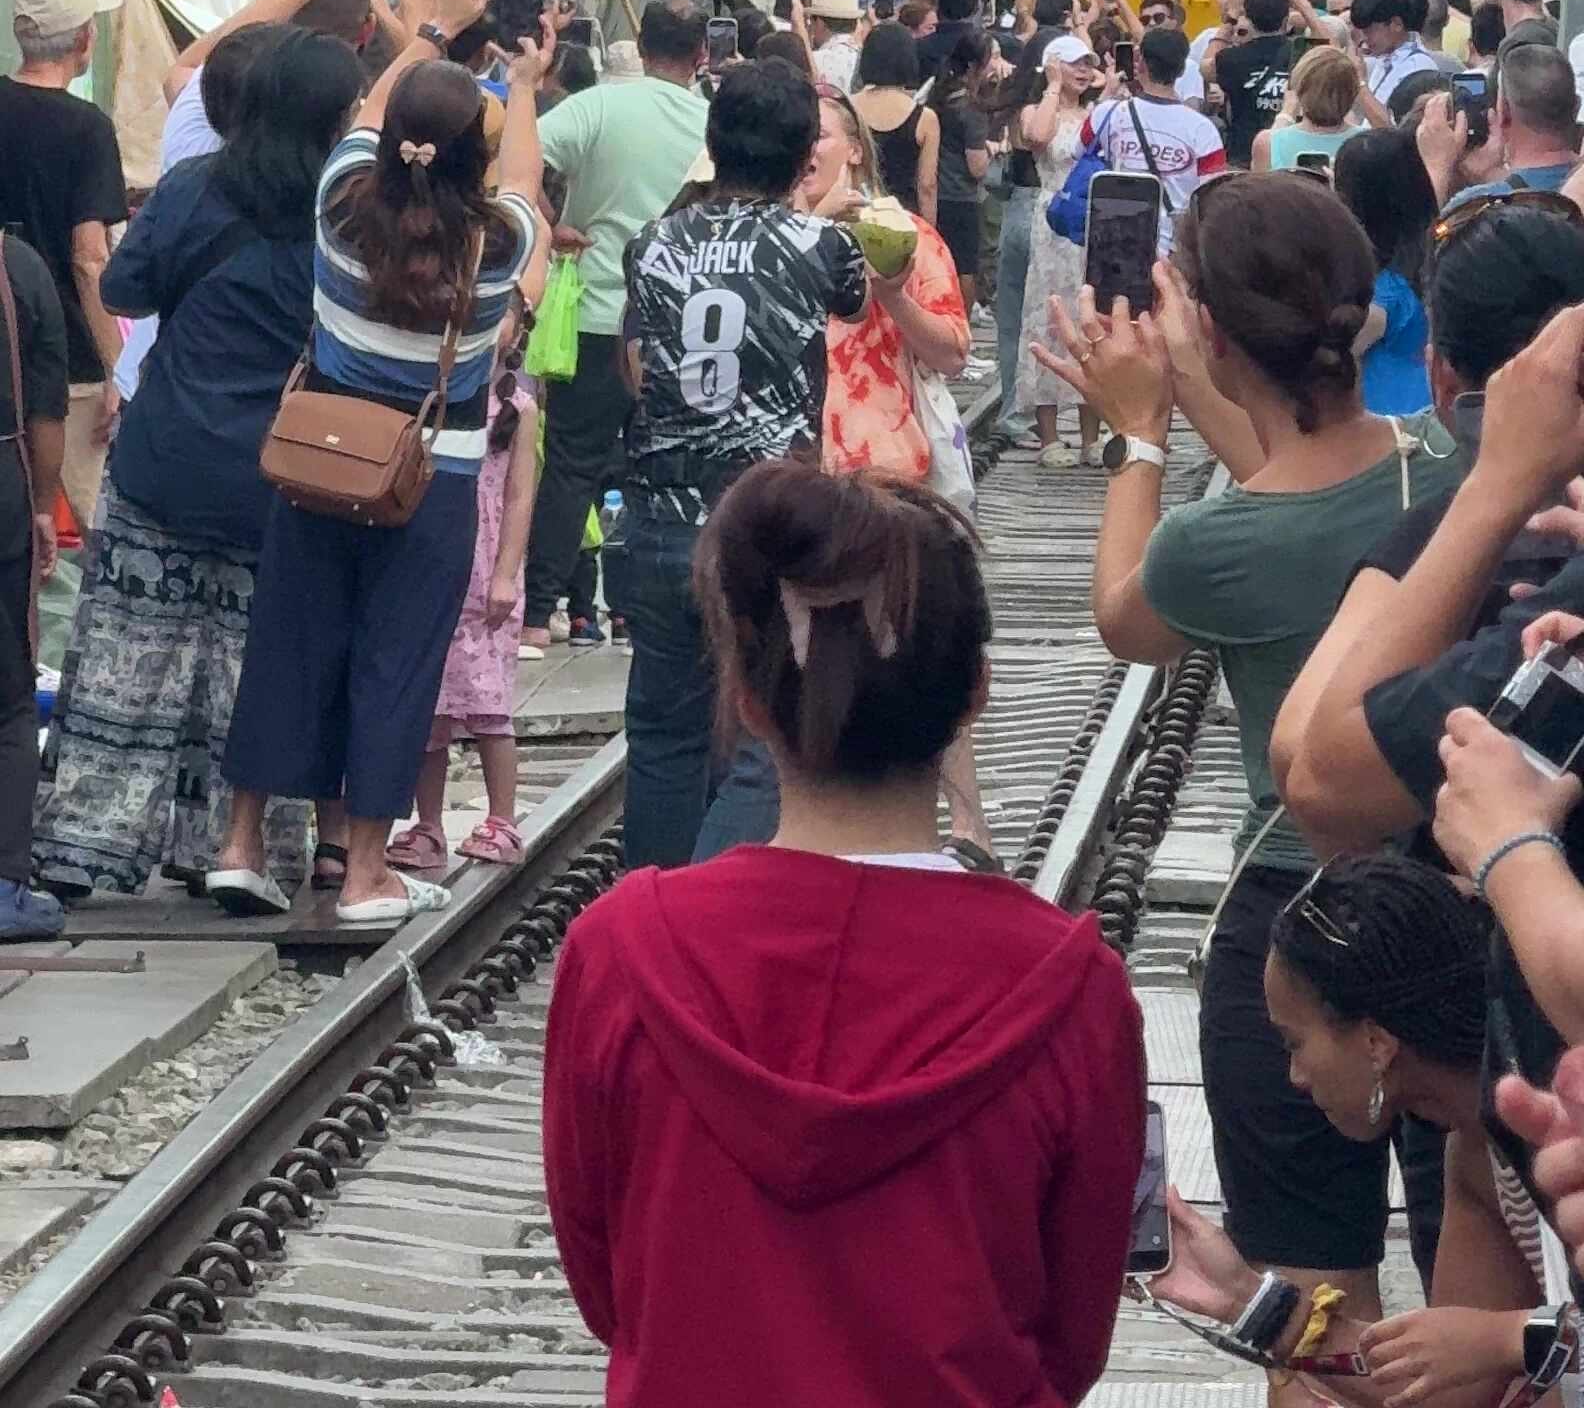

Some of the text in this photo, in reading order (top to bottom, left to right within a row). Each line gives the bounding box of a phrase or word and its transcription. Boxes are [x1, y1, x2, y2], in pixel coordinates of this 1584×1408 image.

[1120, 139, 1185, 163] PDES
[688, 240, 758, 274] JACK
[679, 288, 746, 413] 8
